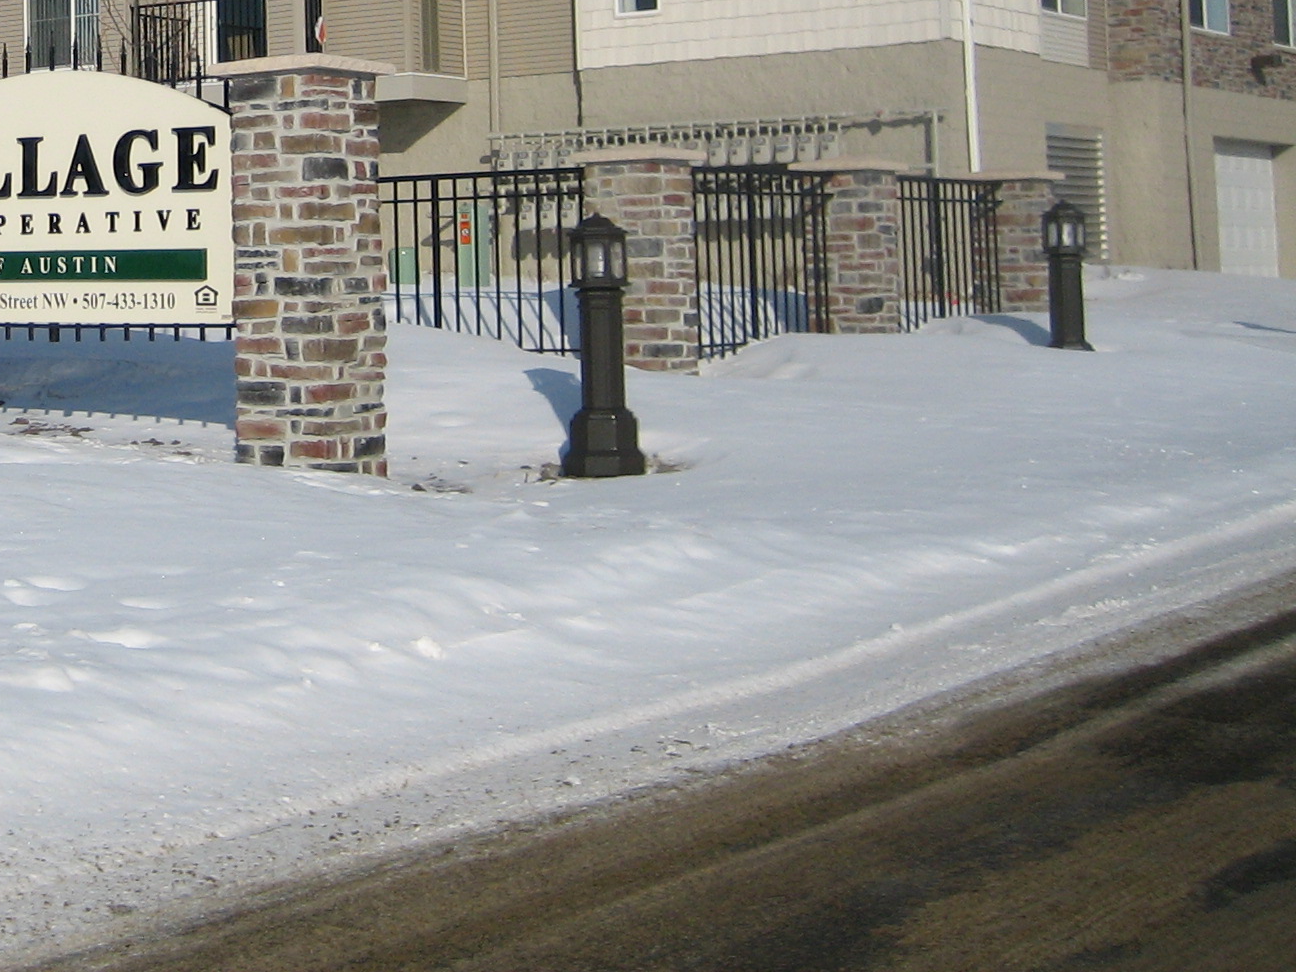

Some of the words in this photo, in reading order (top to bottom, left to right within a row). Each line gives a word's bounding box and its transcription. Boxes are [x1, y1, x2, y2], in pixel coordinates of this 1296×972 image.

[20, 255, 118, 275] AUSTIN
[0, 293, 39, 309] Street
[42, 292, 69, 309] NW
[82, 292, 176, 310] 507-433-1310
